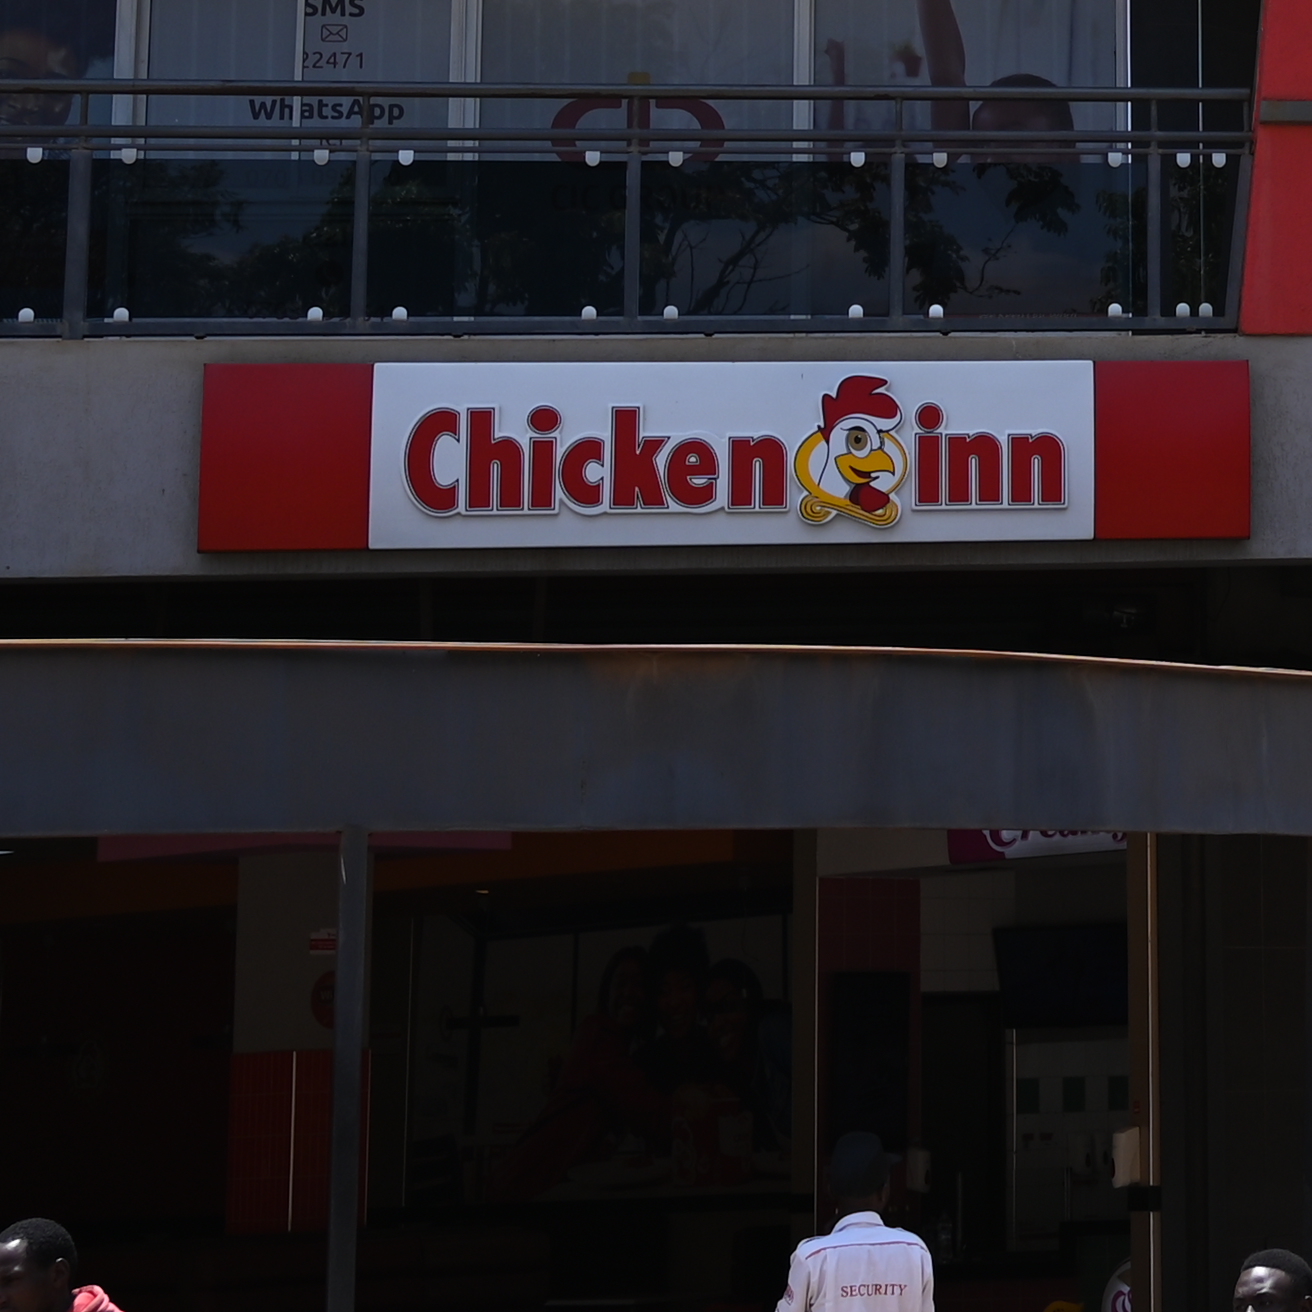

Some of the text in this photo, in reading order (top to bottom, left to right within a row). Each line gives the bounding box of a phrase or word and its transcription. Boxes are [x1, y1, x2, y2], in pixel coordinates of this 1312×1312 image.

[249, 98, 405, 125] WhatsApp
[404, 402, 1067, 513] Chicken inn
[841, 1283, 907, 1298] SECURITY
